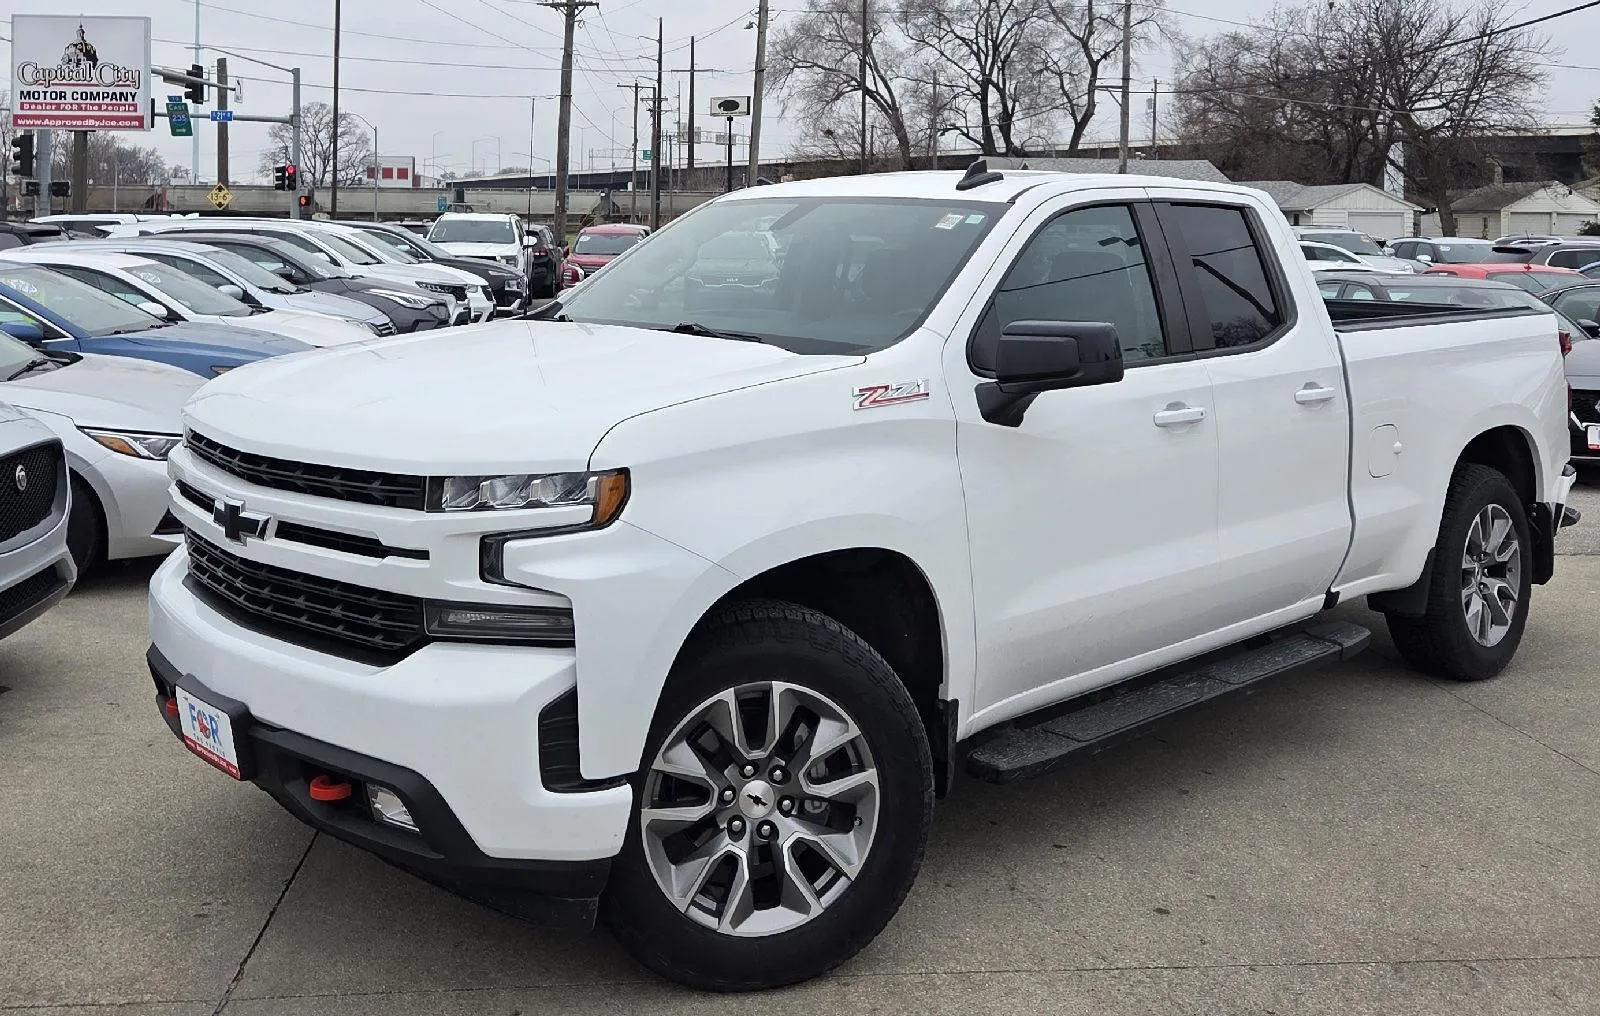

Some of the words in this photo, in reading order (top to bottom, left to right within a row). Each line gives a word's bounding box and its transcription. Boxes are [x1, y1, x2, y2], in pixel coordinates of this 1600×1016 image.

[17, 61, 93, 88] Capital
[95, 62, 140, 89] City
[20, 91, 67, 101] MOTOR
[71, 91, 138, 102] COMPANY
[101, 104, 135, 112] People
[17, 118, 139, 127] www.ApprovedByJoe.com
[172, 114, 187, 122] 235
[852, 379, 930, 411] Z71
